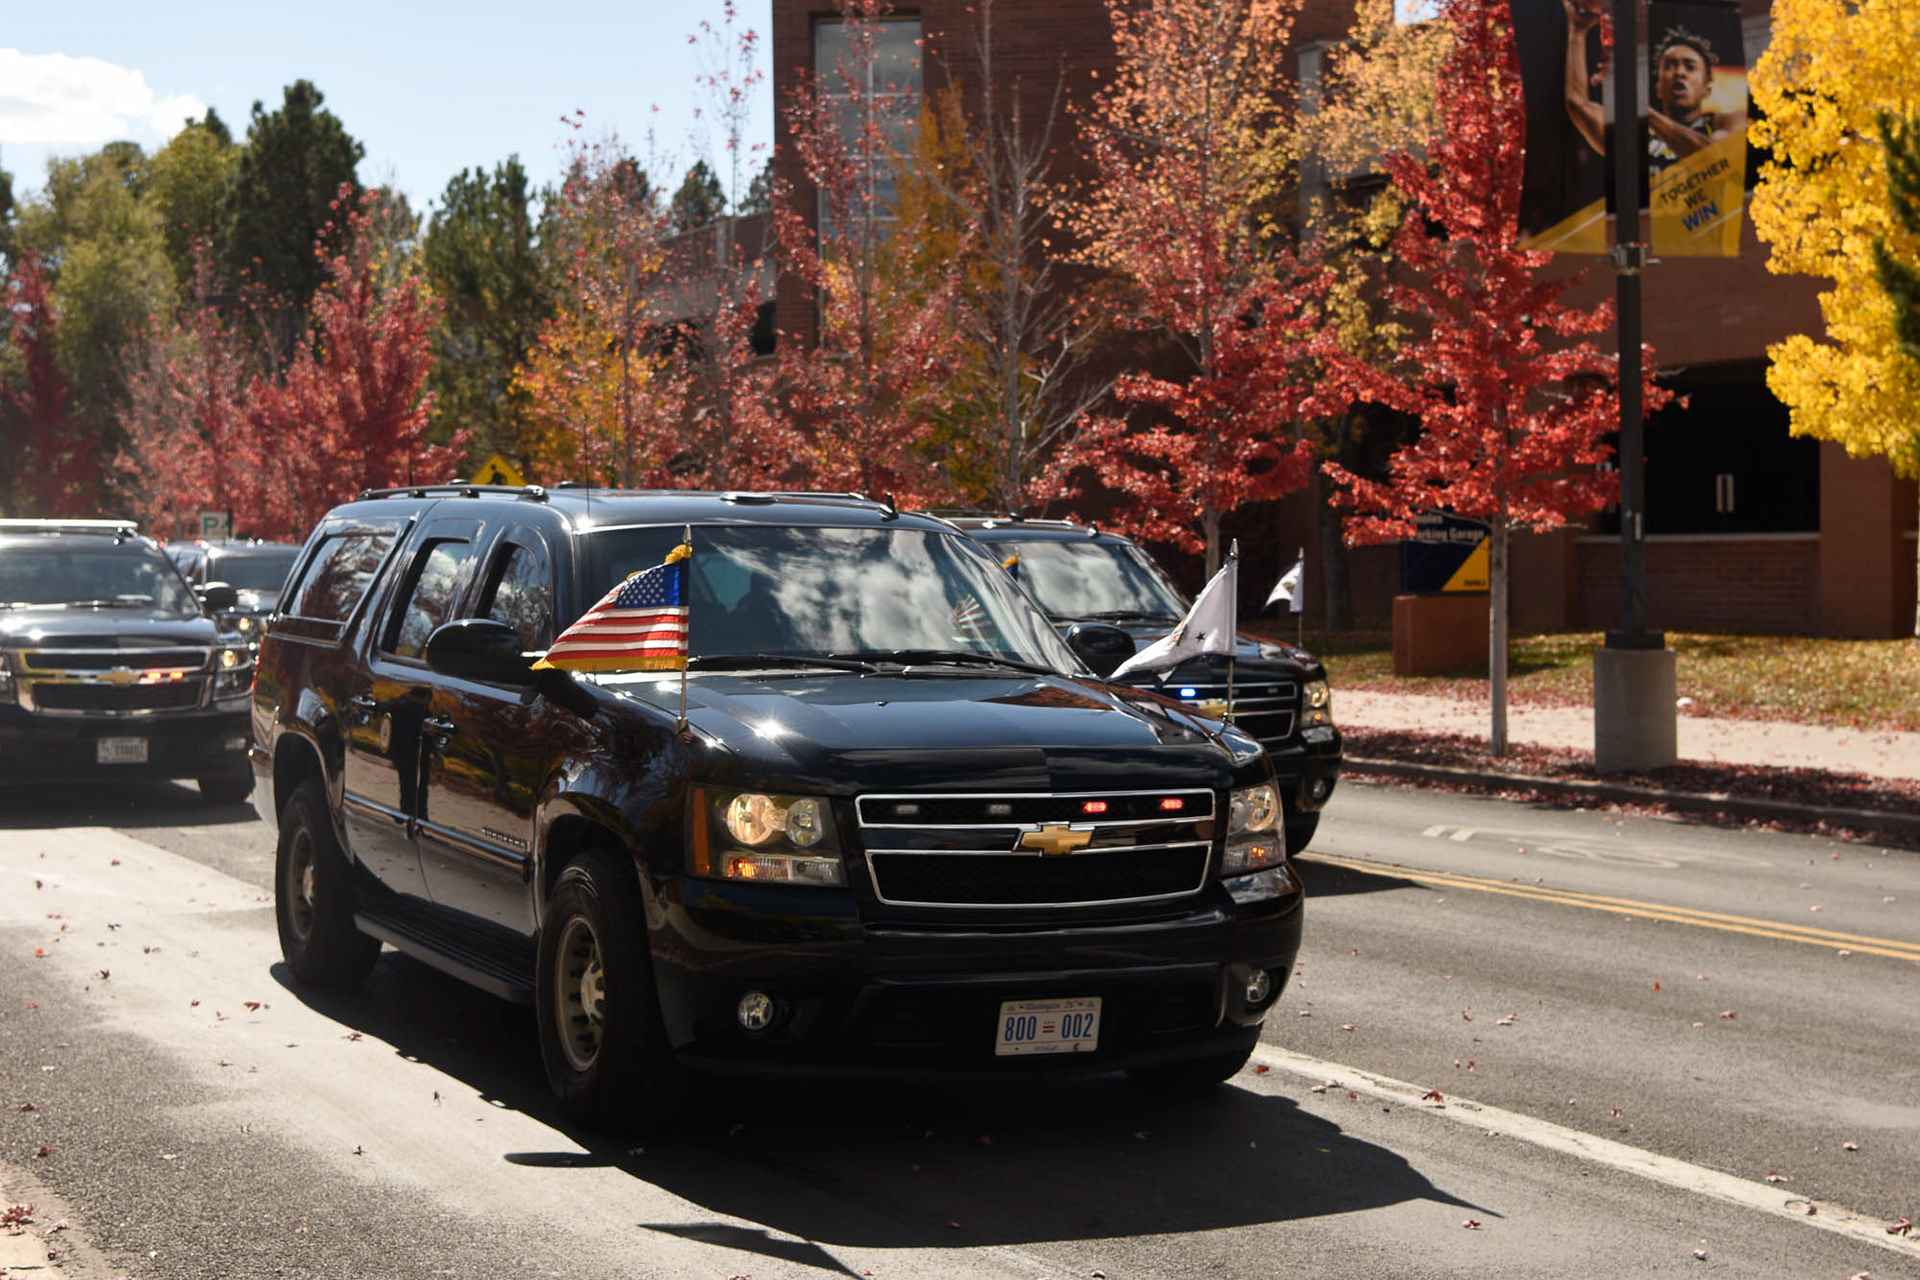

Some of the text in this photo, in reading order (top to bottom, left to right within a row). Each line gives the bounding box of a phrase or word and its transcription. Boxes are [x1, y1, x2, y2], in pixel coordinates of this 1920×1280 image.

[1660, 158, 1730, 204] TOGETHER
[1684, 189, 1708, 209] WE
[1681, 201, 1719, 232] WIN
[1004, 1012, 1094, 1041] 800 002
